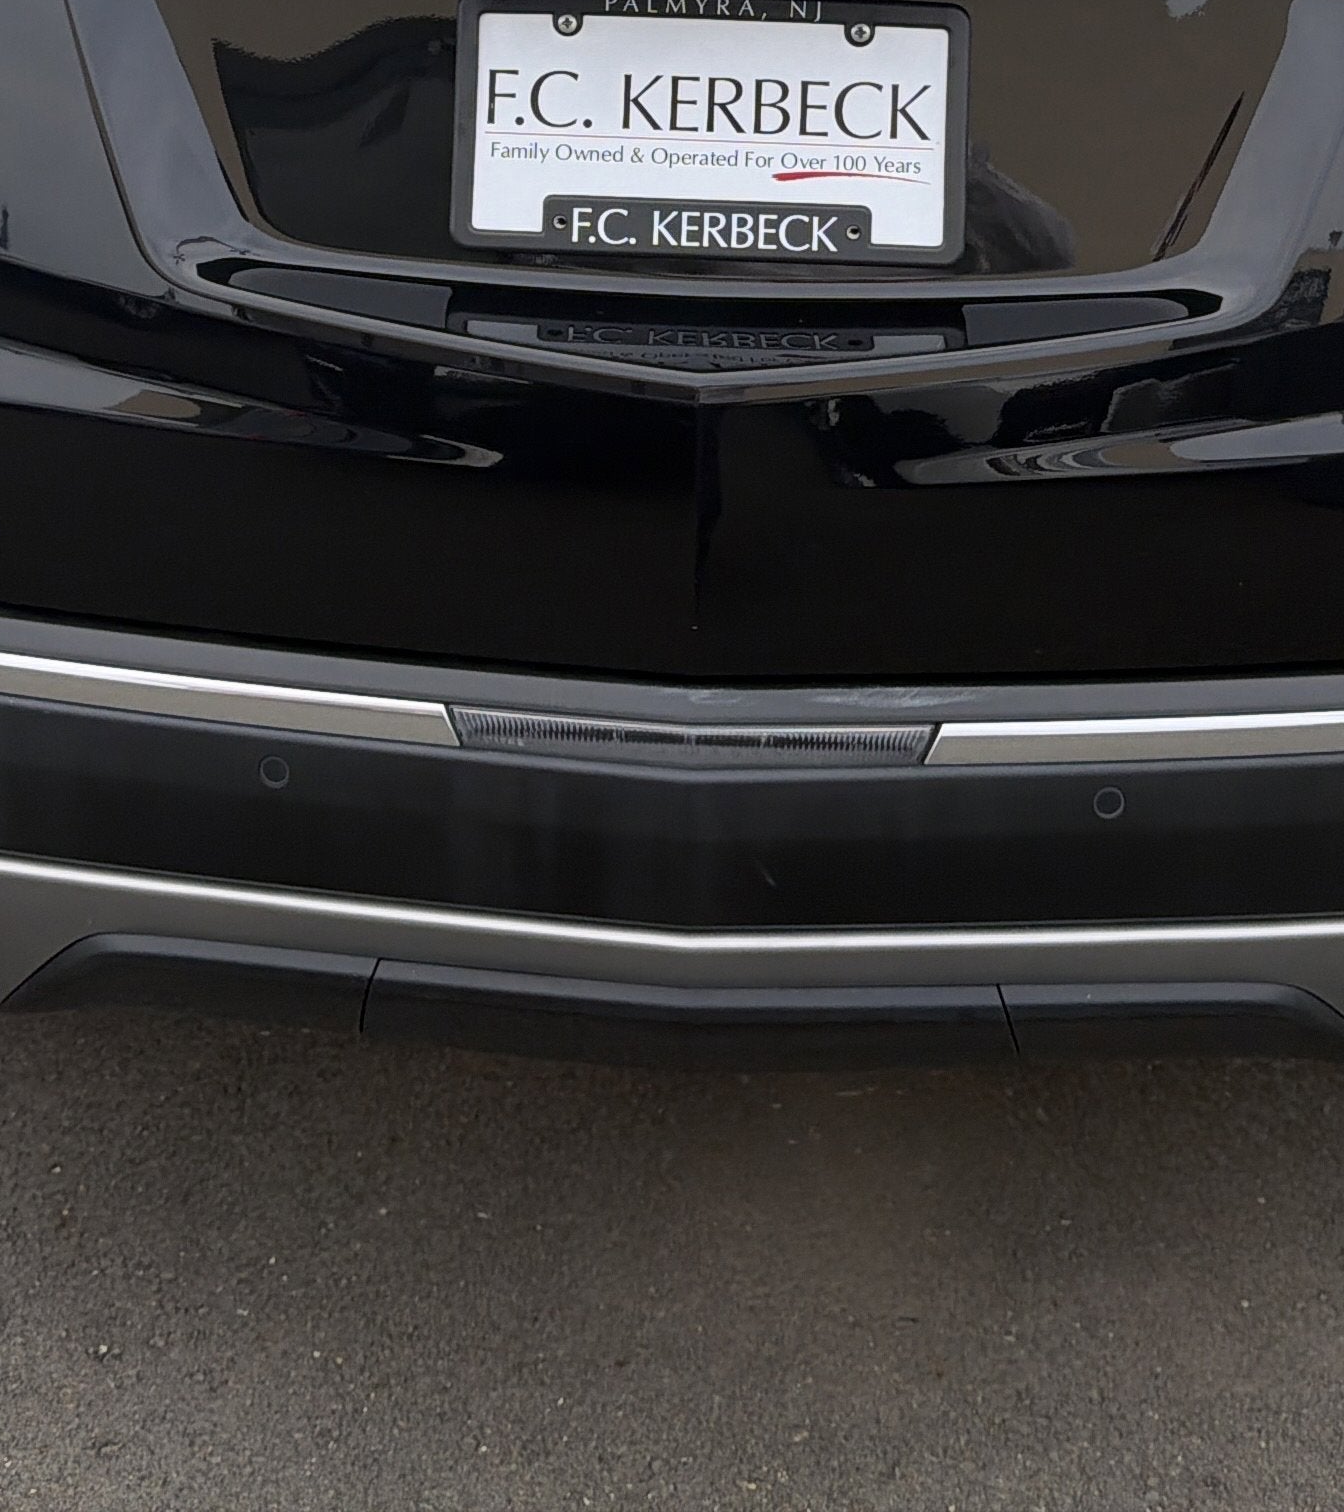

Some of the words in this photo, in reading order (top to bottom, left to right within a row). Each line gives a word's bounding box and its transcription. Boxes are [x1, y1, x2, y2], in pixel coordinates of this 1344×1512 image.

[789, 0, 822, 23] NJ
[487, 69, 593, 129] F.C.
[622, 73, 932, 141] KERBECK
[490, 141, 549, 163] Family
[555, 143, 624, 163] Owned
[630, 147, 644, 163] &
[651, 145, 738, 168] Operated
[745, 151, 774, 168] For
[781, 152, 826, 170] Over
[833, 154, 866, 171] 100
[874, 155, 921, 174] Years
[571, 207, 637, 245] F.C.
[652, 210, 839, 252] KERBECK
